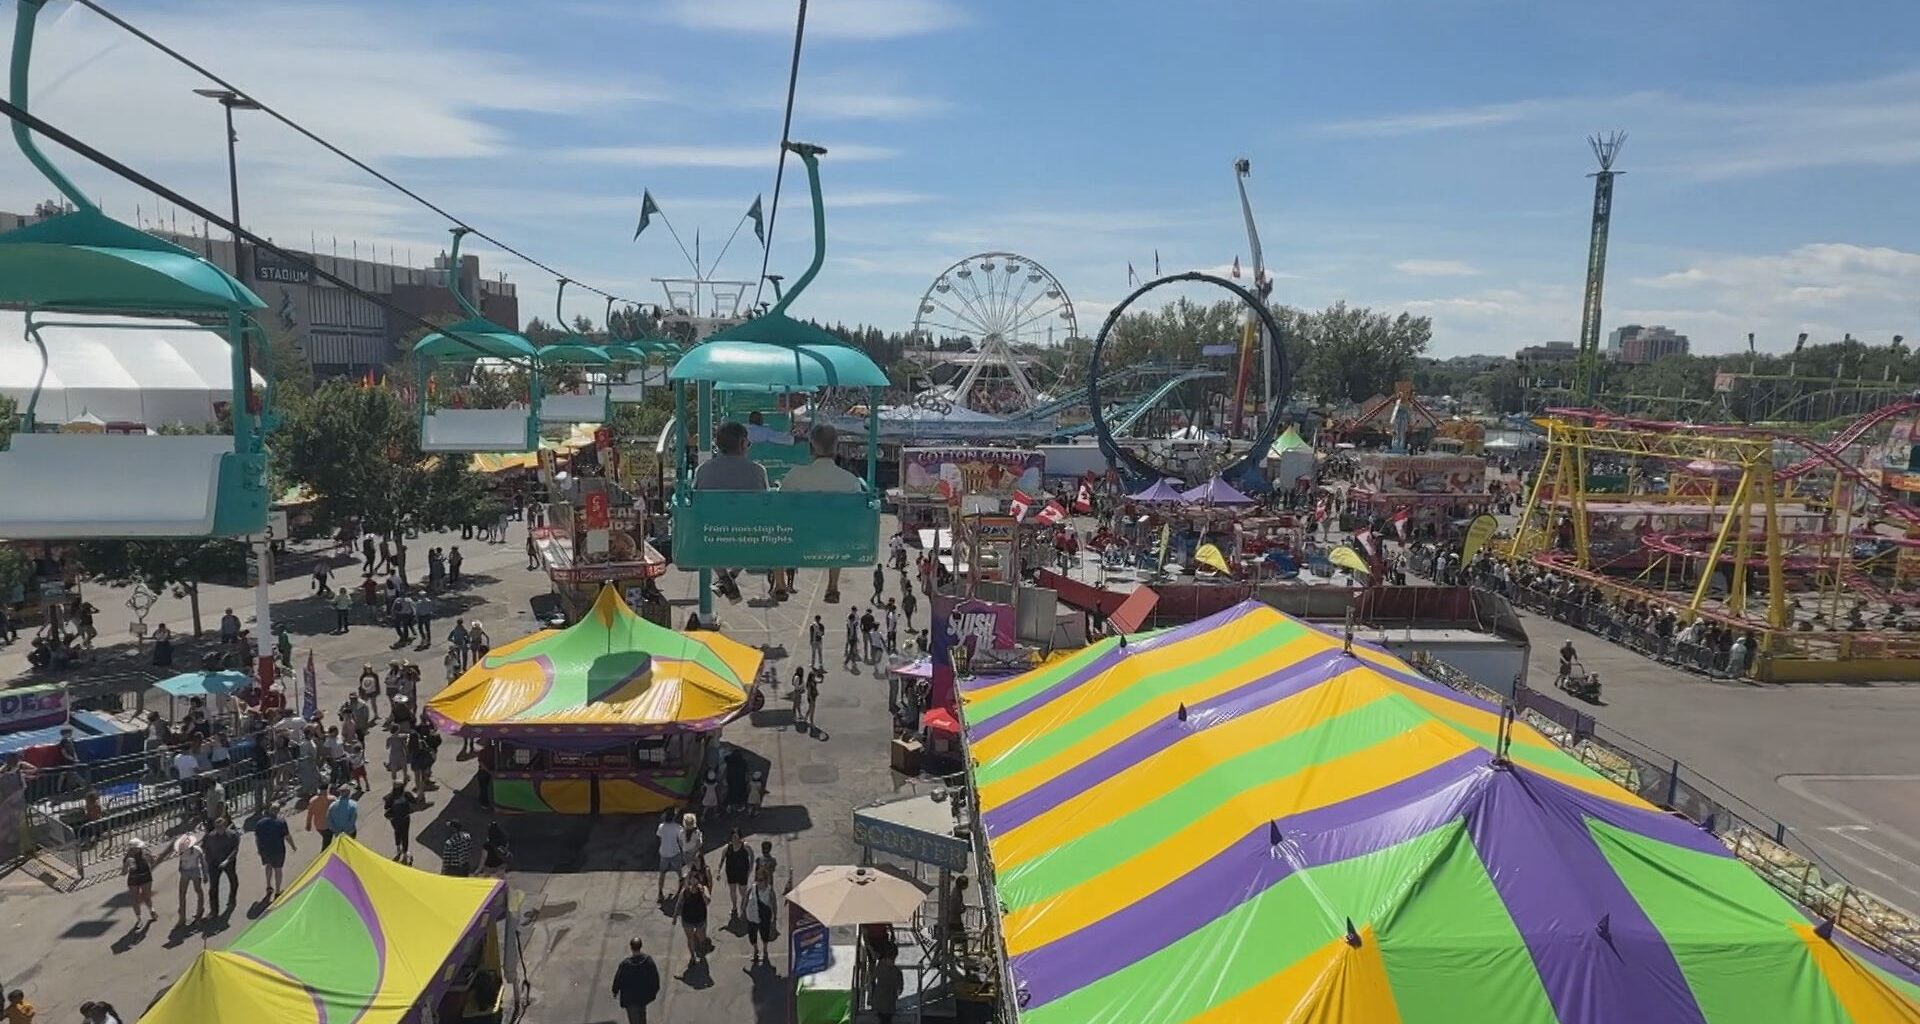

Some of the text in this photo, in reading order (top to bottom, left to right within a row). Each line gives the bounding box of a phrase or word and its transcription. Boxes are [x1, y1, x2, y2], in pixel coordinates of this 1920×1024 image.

[260, 266, 309, 282] STADIUM
[918, 451, 1030, 465] COTTON CANDY
[704, 524, 729, 532] From
[731, 525, 774, 534] non-stop
[716, 536, 759, 544] non-stop
[947, 612, 997, 638] SLUSH
[855, 822, 964, 866] SCOOTER
